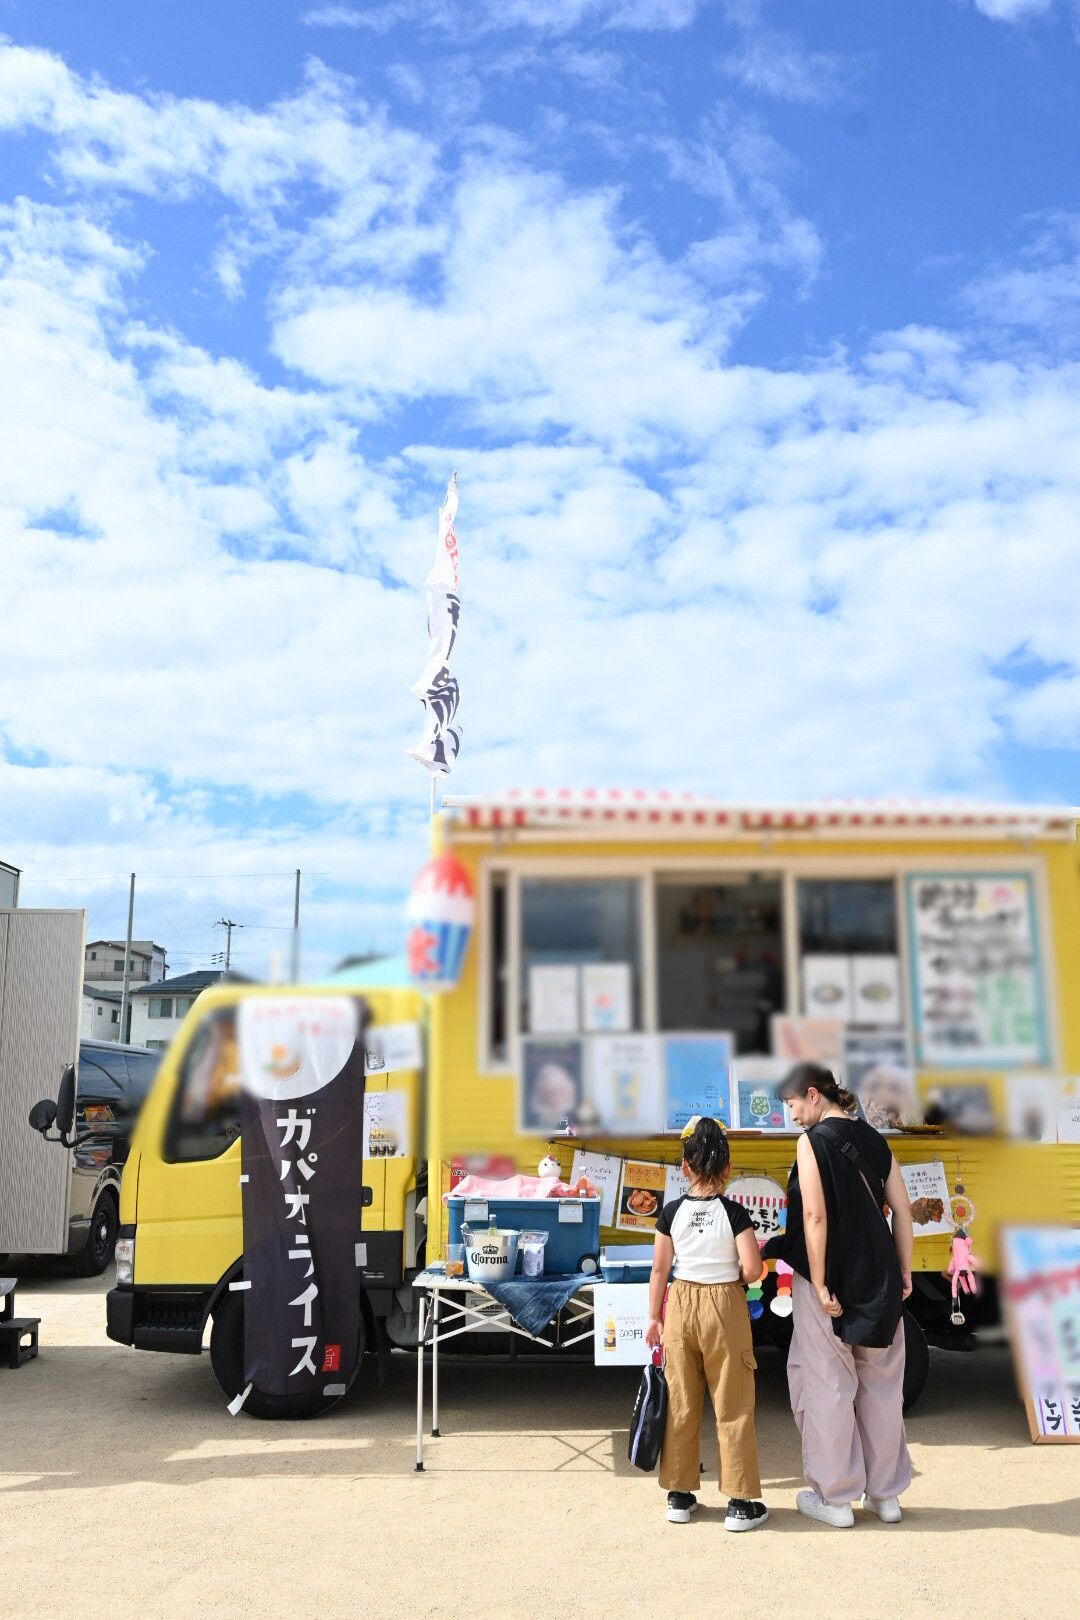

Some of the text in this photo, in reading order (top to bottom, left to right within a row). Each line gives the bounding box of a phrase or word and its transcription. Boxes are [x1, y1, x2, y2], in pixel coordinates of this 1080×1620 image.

[628, 1167, 660, 1177] あみあみ
[276, 1108, 318, 1376] ガパオライス
[471, 1252, 509, 1266] Corona
